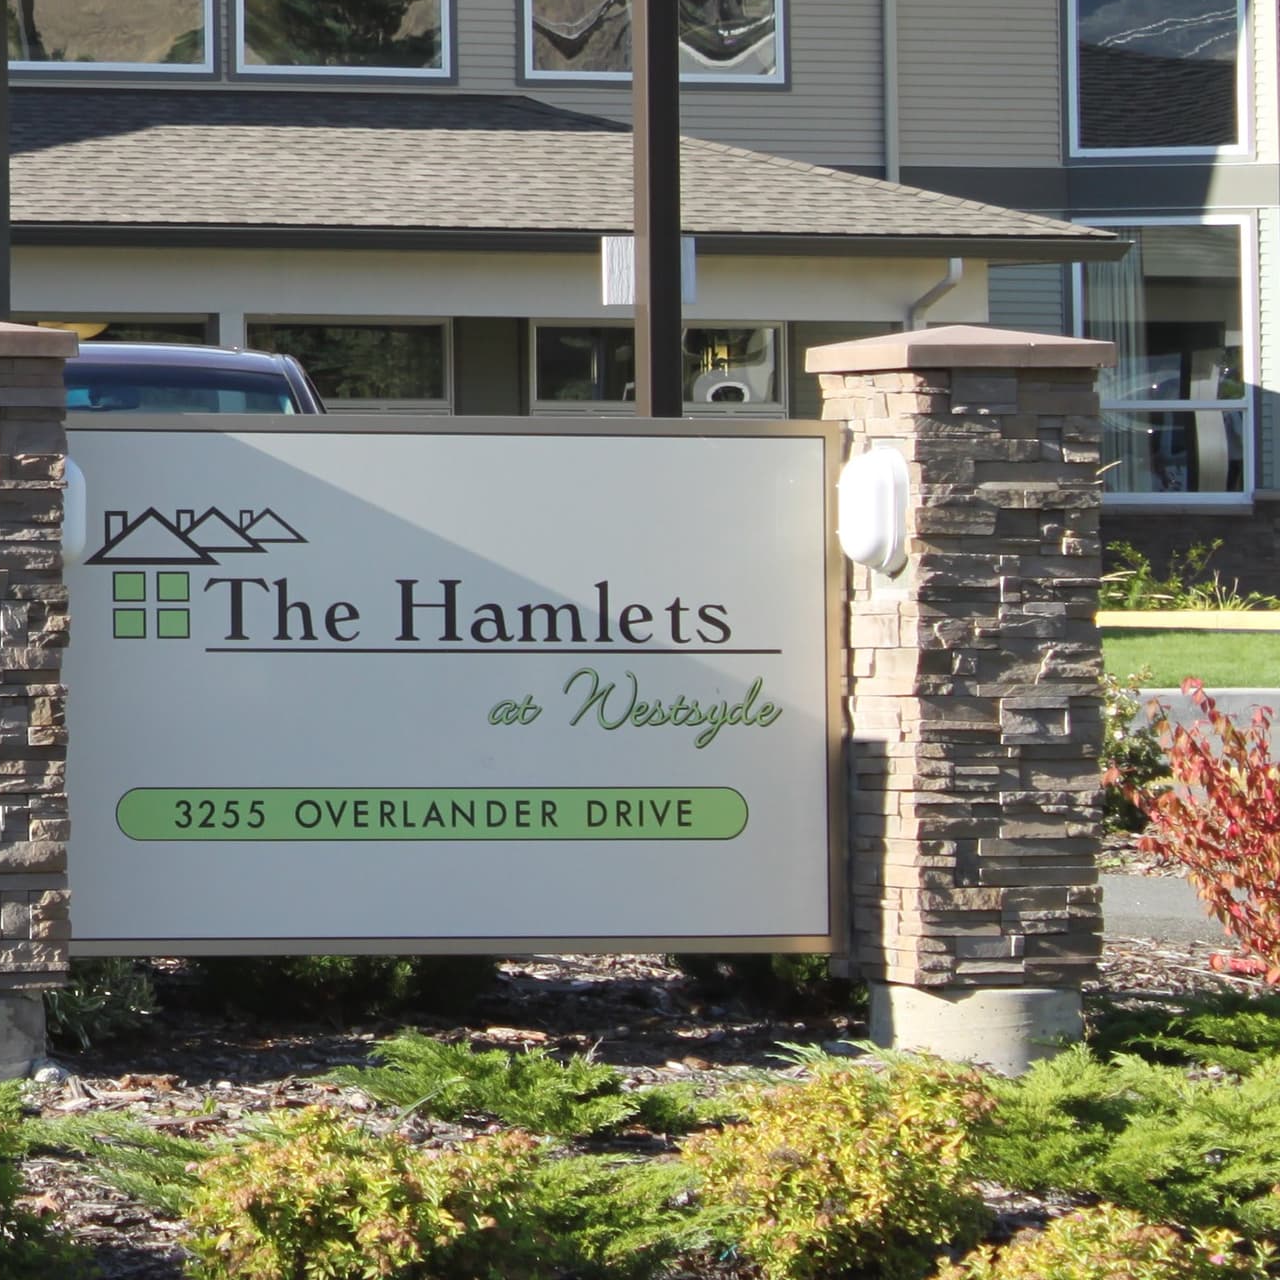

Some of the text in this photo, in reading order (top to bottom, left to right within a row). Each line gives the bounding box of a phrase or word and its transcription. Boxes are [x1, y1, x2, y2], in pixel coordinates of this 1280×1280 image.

[203, 577, 732, 644] The Hamlets
[488, 667, 784, 750] at Westsyde
[173, 799, 693, 829] 3255 OVERLANDER DRIVE
